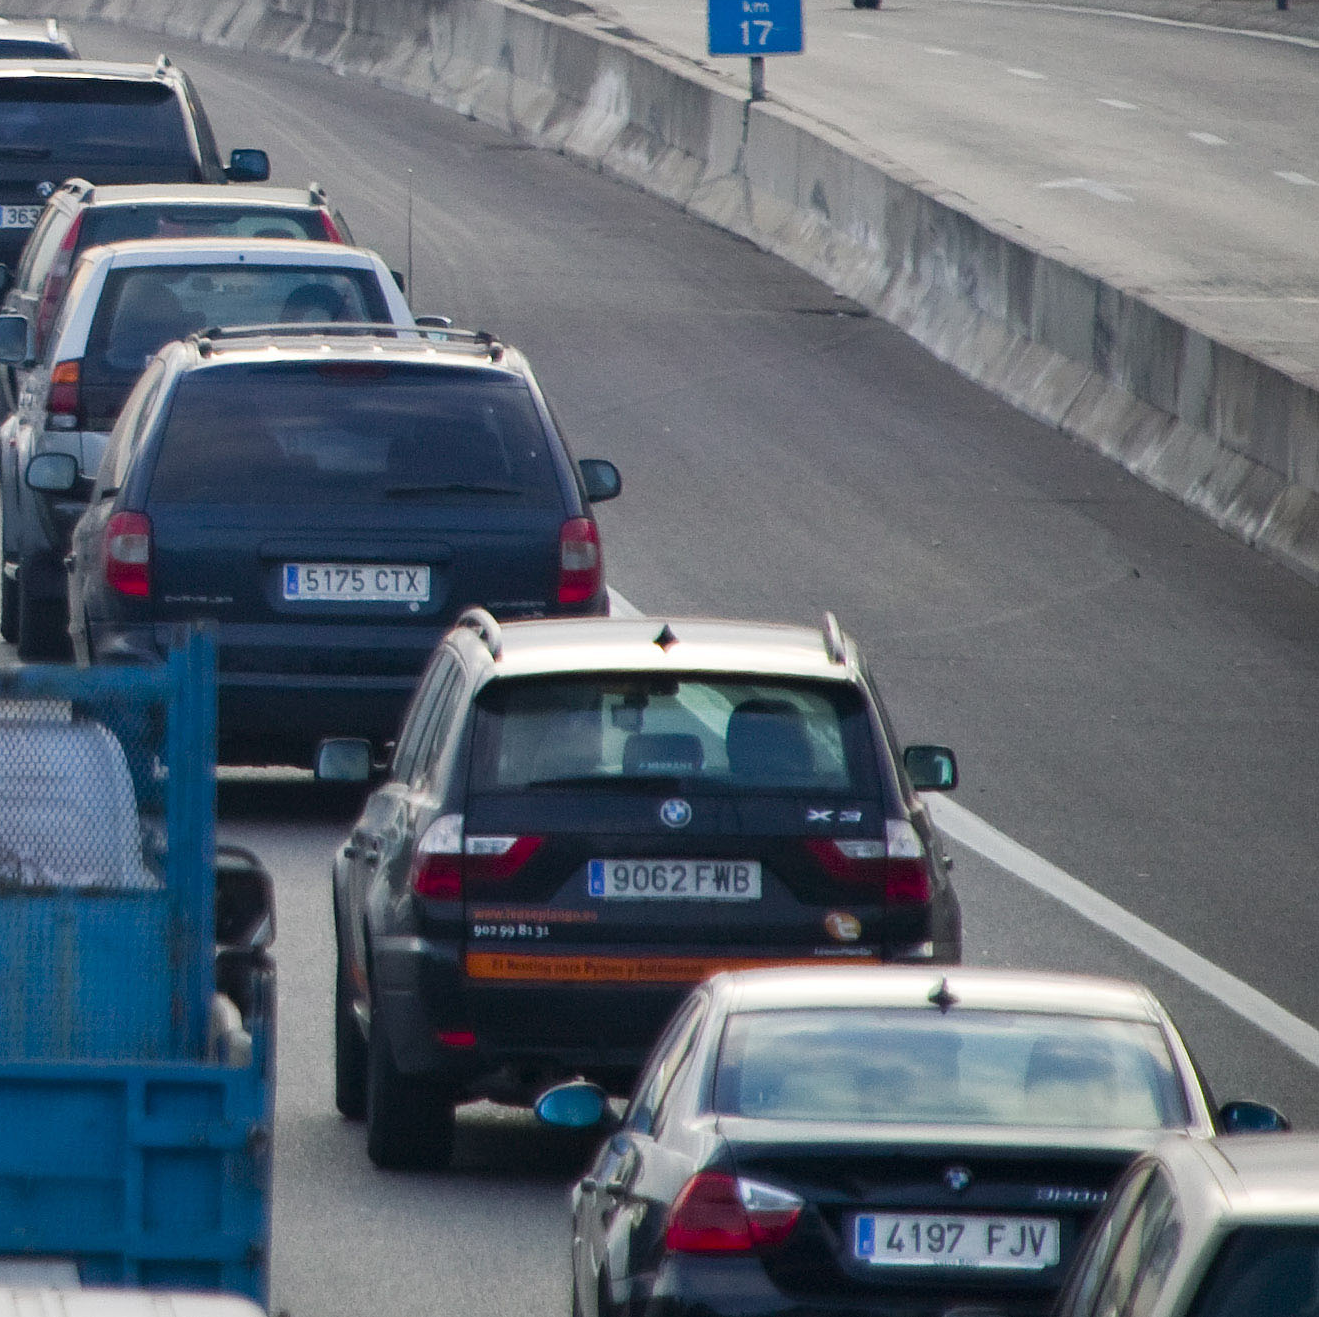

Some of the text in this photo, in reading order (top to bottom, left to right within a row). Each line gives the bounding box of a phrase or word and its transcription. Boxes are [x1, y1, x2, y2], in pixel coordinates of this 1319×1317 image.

[742, 0, 770, 13] km
[740, 19, 774, 46] 17
[7, 208, 45, 225] 363
[305, 569, 420, 595] 5175 CTX
[612, 864, 751, 894] 9062 FWB
[473, 923, 550, 938] 902 99 81 31
[885, 1221, 1048, 1258] 4197 FJV
